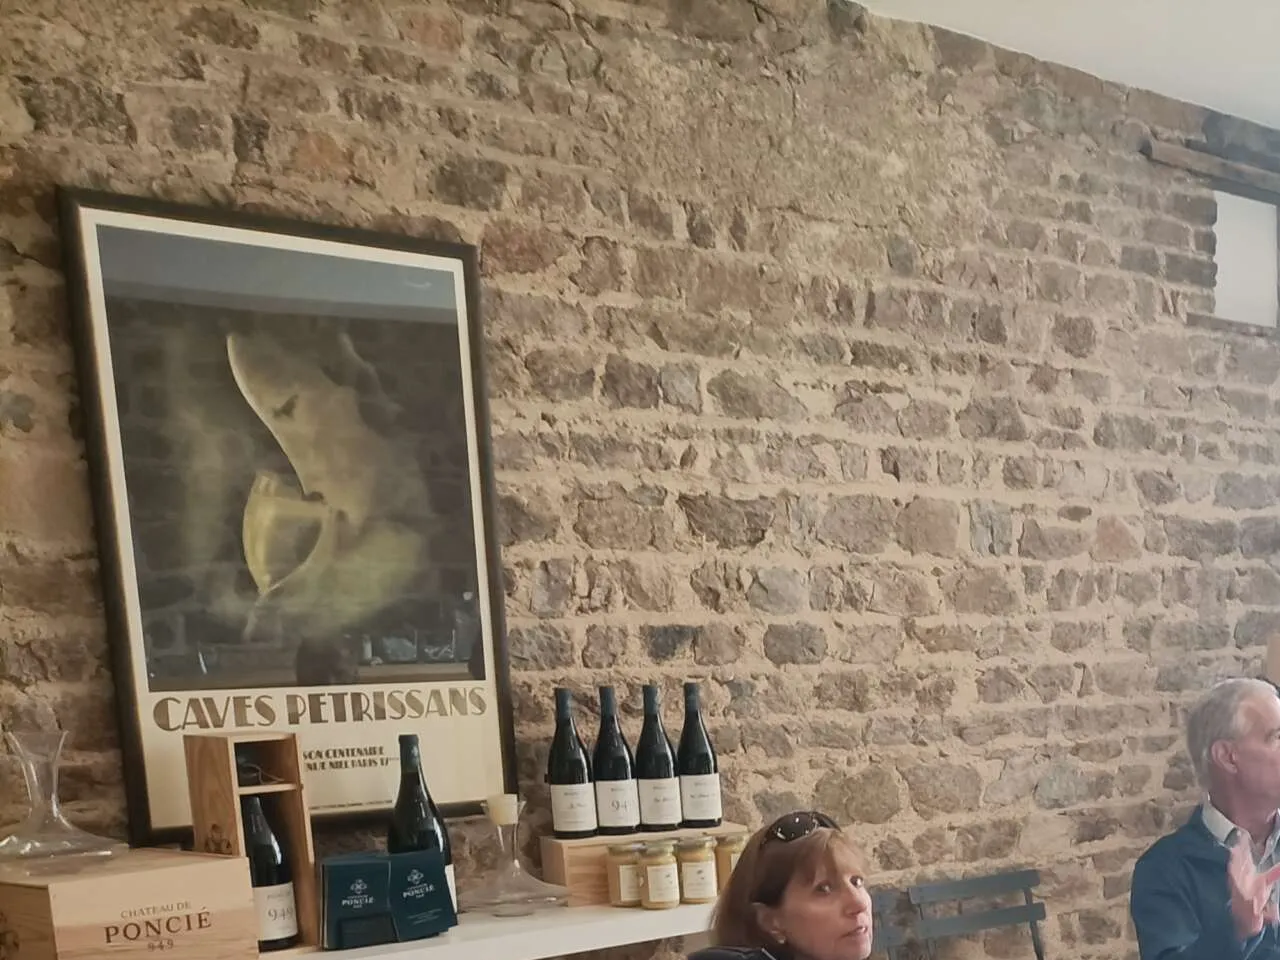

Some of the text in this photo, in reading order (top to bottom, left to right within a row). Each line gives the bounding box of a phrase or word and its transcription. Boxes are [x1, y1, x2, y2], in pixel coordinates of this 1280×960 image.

[152, 686, 487, 732] CAVES PETRISSANS
[324, 745, 385, 759] CENTENAIRE
[176, 900, 192, 911] DE
[103, 906, 213, 944] PONCIÉ
